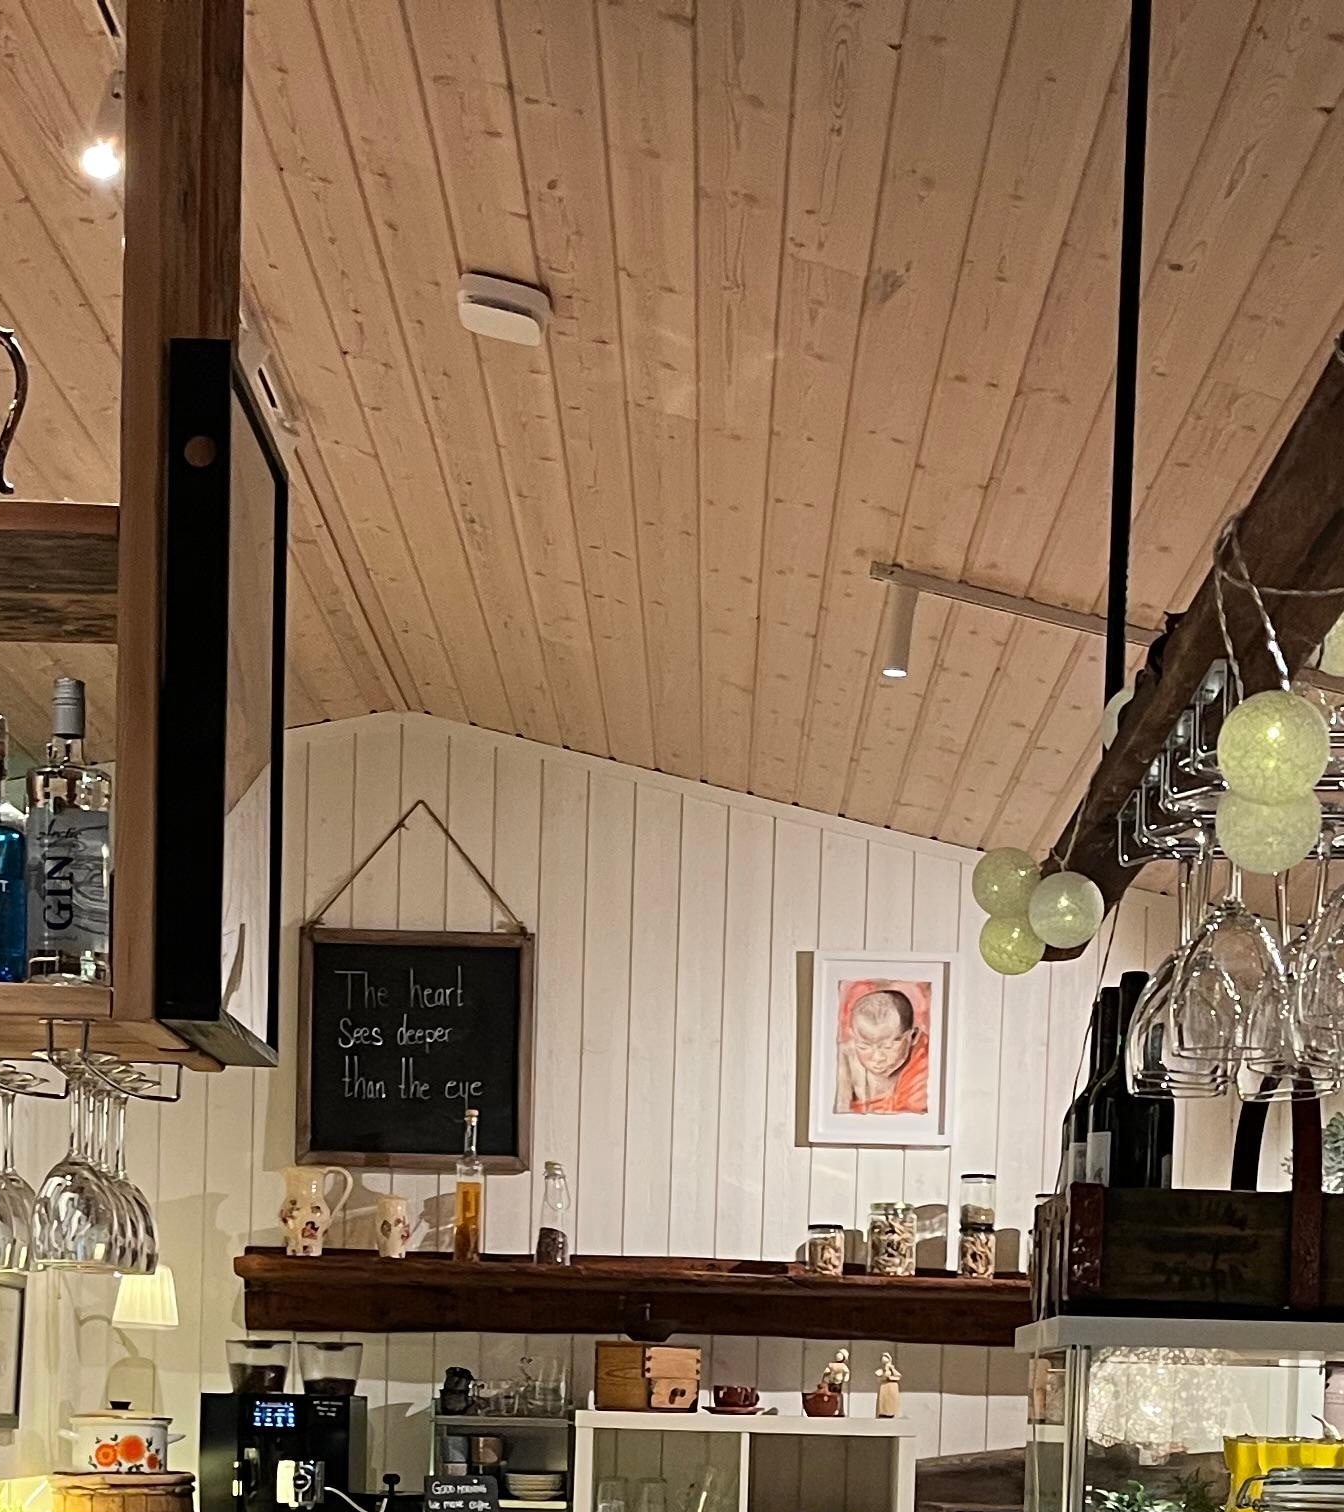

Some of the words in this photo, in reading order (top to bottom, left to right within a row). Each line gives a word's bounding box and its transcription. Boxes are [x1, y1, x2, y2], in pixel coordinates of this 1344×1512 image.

[43, 856, 74, 931] GIN
[334, 970, 389, 1010] The
[410, 965, 464, 1009] heart
[397, 1014, 454, 1054] deeper
[399, 1057, 431, 1100] the
[444, 1080, 484, 1109] eye
